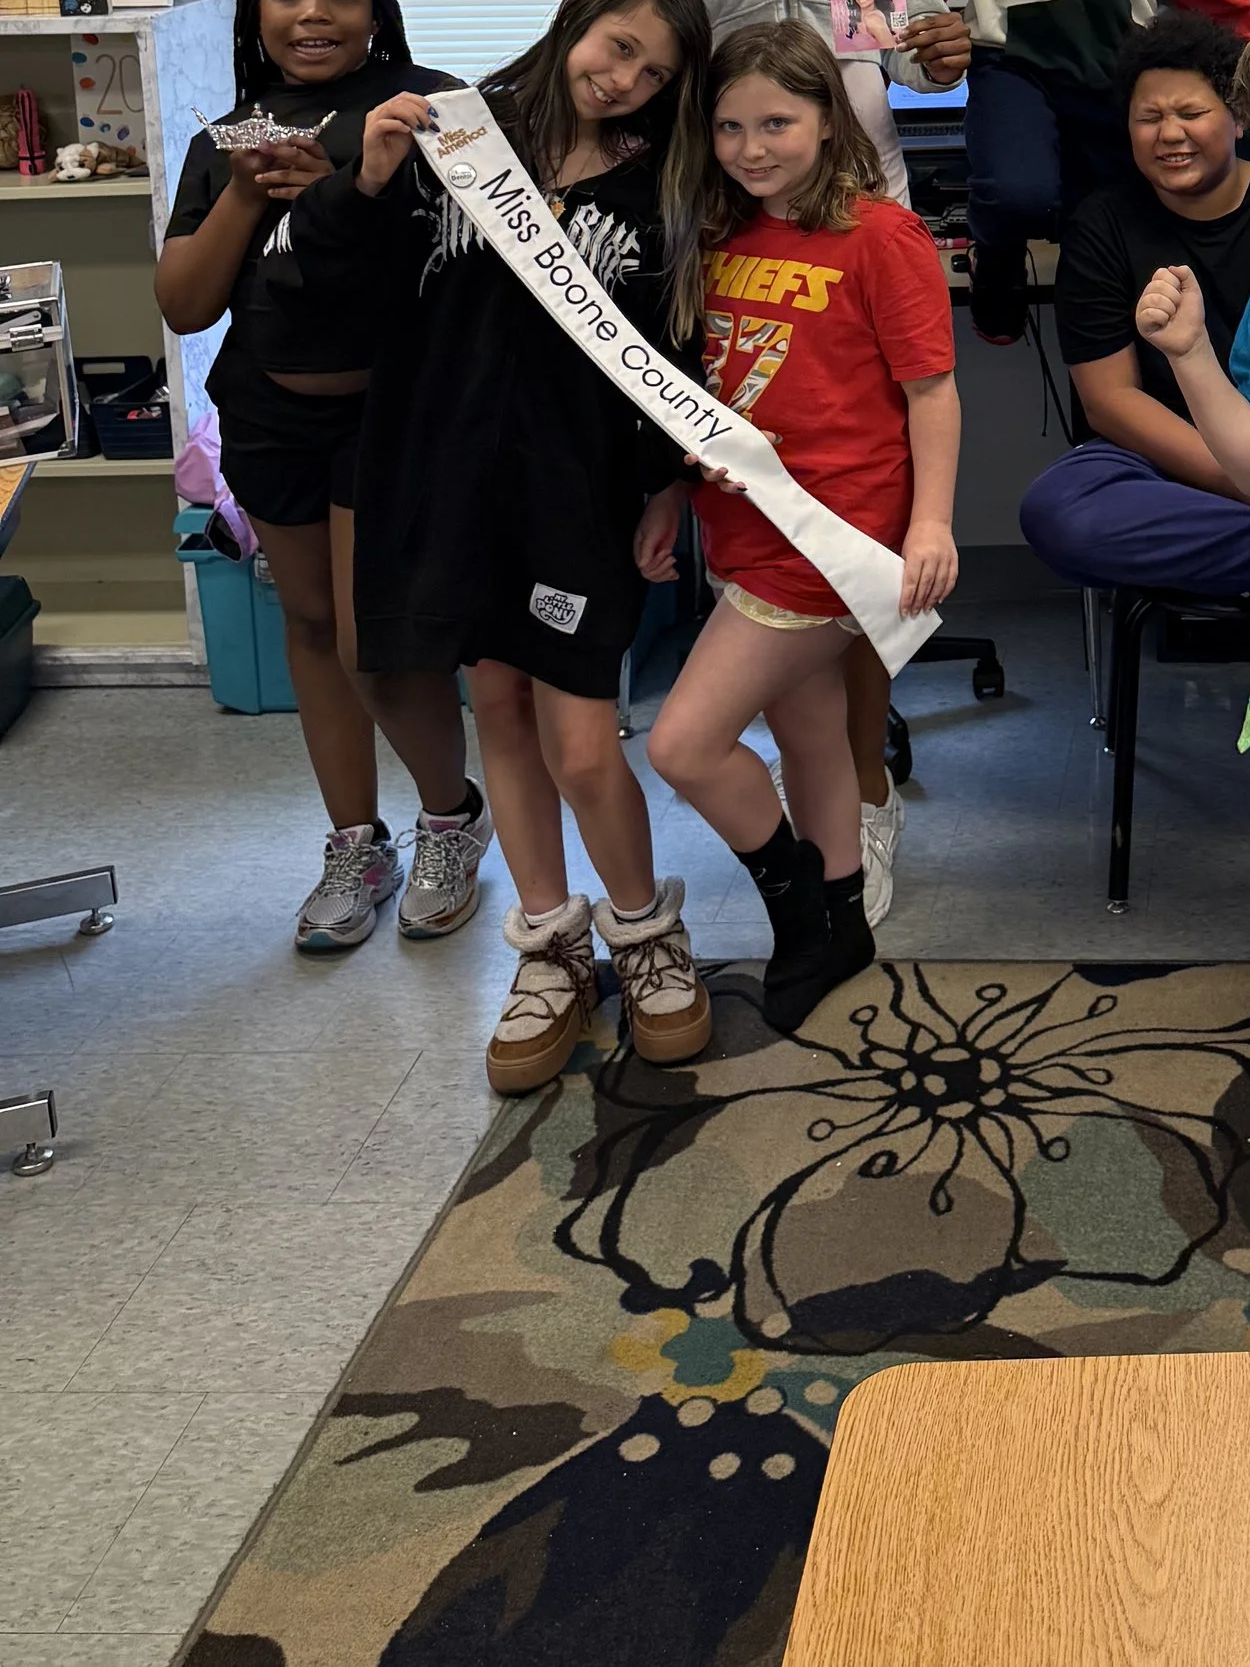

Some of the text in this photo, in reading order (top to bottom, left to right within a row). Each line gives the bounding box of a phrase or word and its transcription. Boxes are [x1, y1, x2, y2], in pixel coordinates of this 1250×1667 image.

[437, 128, 467, 146] Miss
[437, 126, 488, 159] America
[479, 168, 541, 243] Miss
[533, 240, 618, 342] Boone
[620, 343, 732, 444] County
[554, 593, 568, 603] MY
